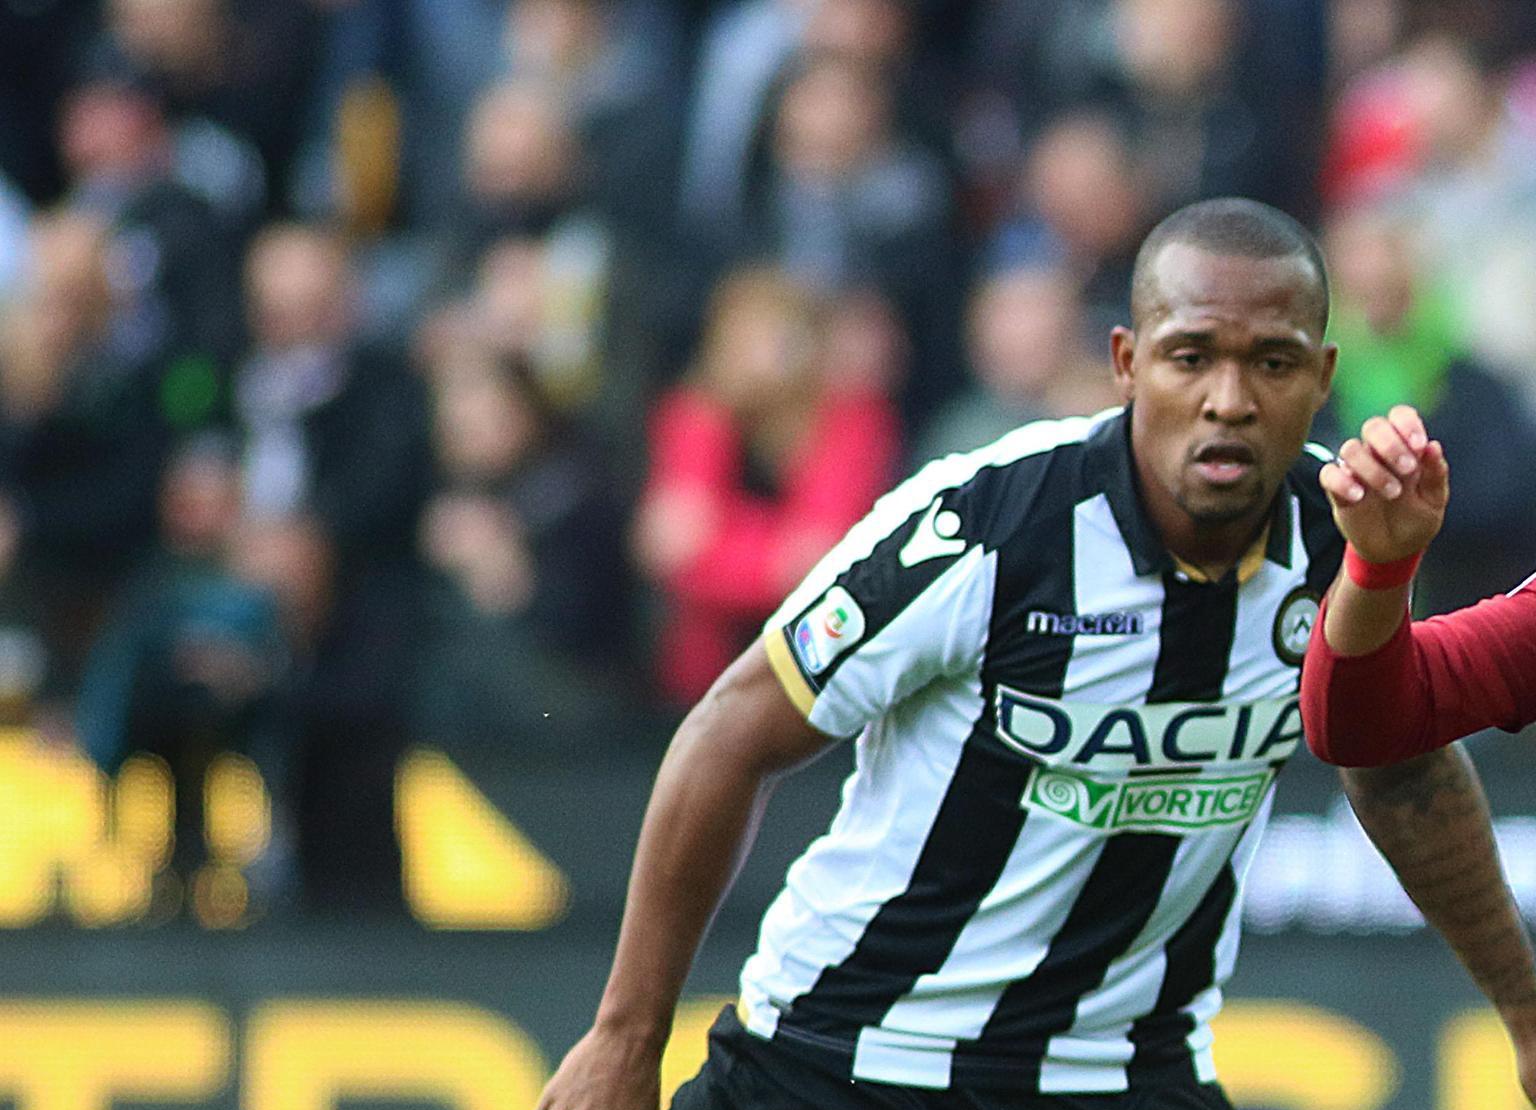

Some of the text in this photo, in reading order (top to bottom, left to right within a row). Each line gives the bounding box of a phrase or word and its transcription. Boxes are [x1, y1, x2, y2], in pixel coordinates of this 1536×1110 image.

[1026, 610, 1143, 636] macron
[1000, 691, 1301, 765] DACIA
[1127, 784, 1258, 817] VORTICE
